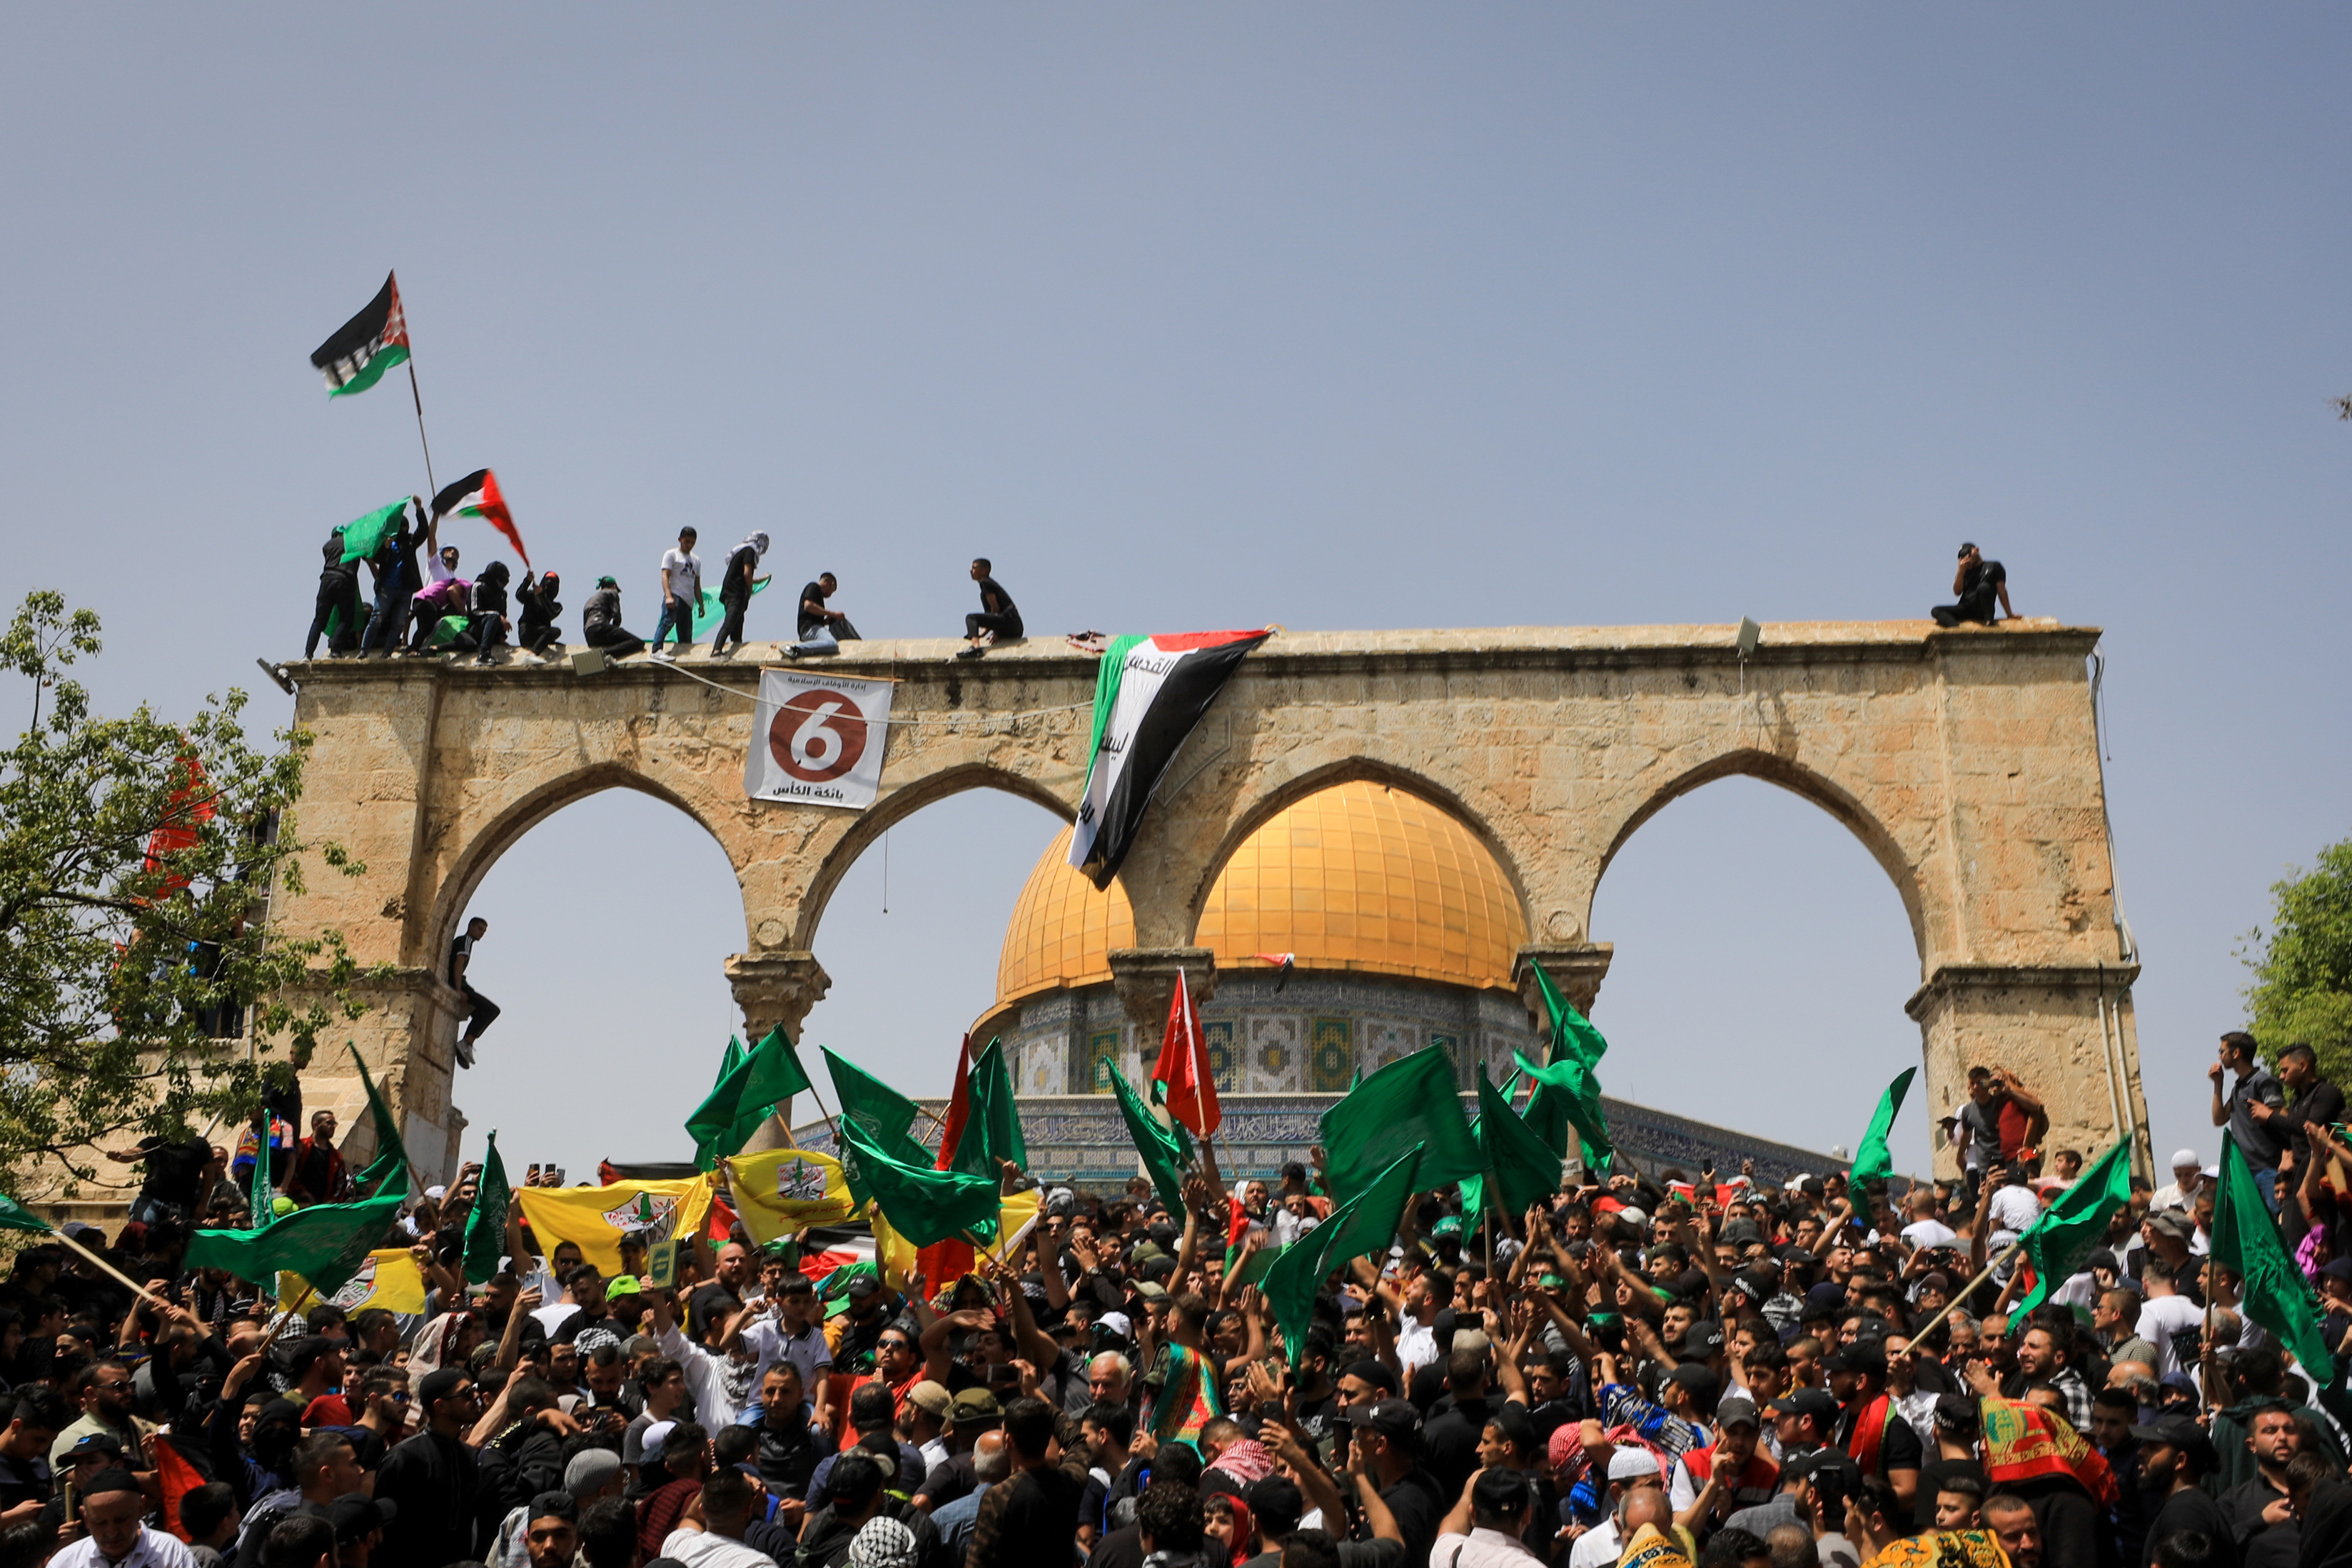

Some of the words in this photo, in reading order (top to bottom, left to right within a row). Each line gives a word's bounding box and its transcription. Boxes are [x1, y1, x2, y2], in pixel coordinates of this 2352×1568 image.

[1123, 655, 1176, 677] القدس
[787, 675, 821, 687] الإسلامية
[822, 679, 849, 689] الأوقاف
[850, 682, 867, 692] إدارة
[790, 702, 843, 771] 6
[773, 780, 811, 796] الكأس
